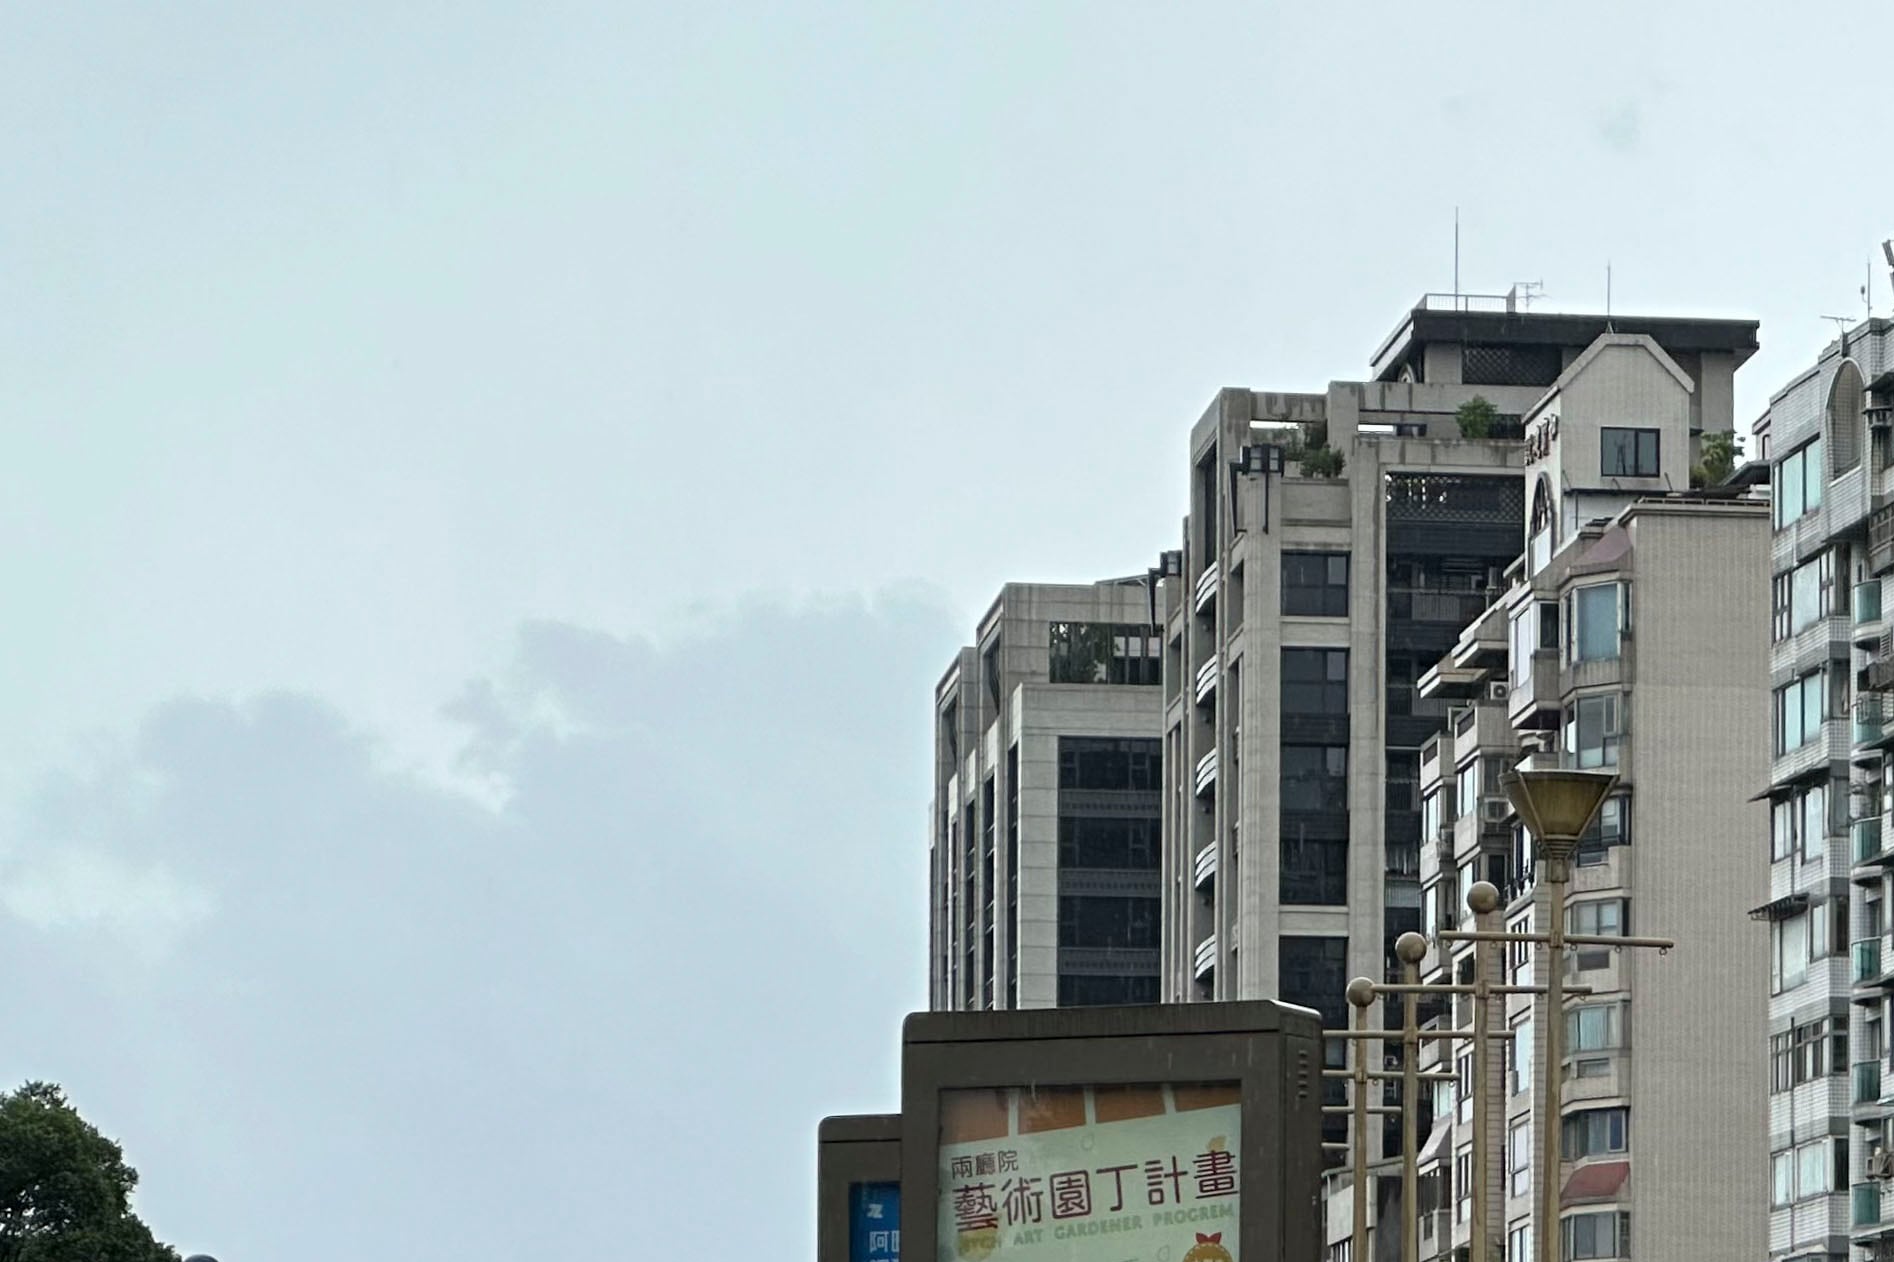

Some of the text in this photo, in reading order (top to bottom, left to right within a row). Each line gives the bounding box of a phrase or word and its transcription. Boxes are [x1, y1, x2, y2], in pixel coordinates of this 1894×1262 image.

[951, 1150, 1018, 1180] 兩廳院
[952, 1149, 1240, 1232] 藝術園丁計畫
[1013, 1229, 1043, 1246] ART
[1054, 1214, 1143, 1239] GARDENER
